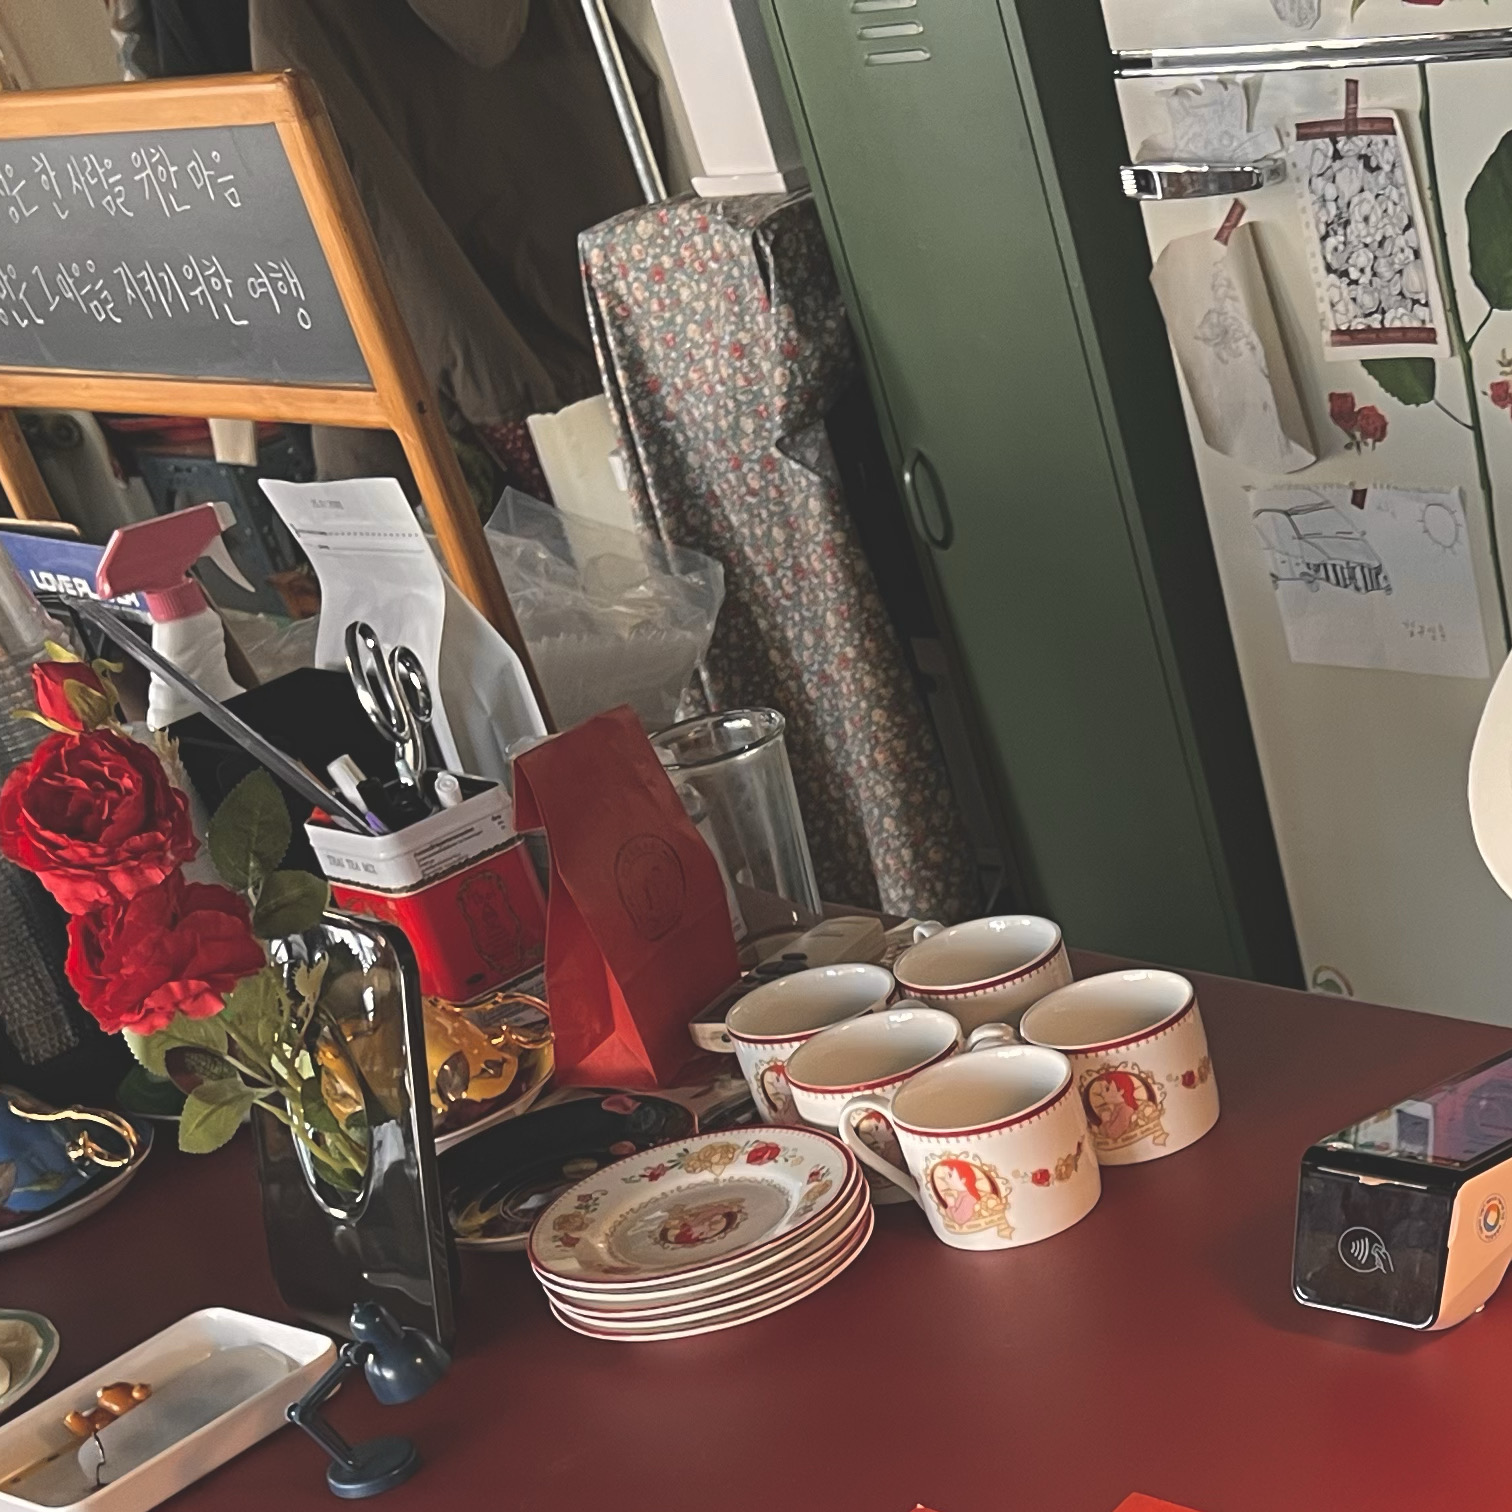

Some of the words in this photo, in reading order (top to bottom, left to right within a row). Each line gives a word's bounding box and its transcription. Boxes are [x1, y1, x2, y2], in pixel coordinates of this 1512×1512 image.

[32, 153, 69, 219] 한
[67, 154, 133, 217] 사람을
[130, 145, 190, 217] 위한
[187, 149, 241, 208] 마음
[247, 257, 311, 329] 여행
[347, 858, 361, 872] TEA
